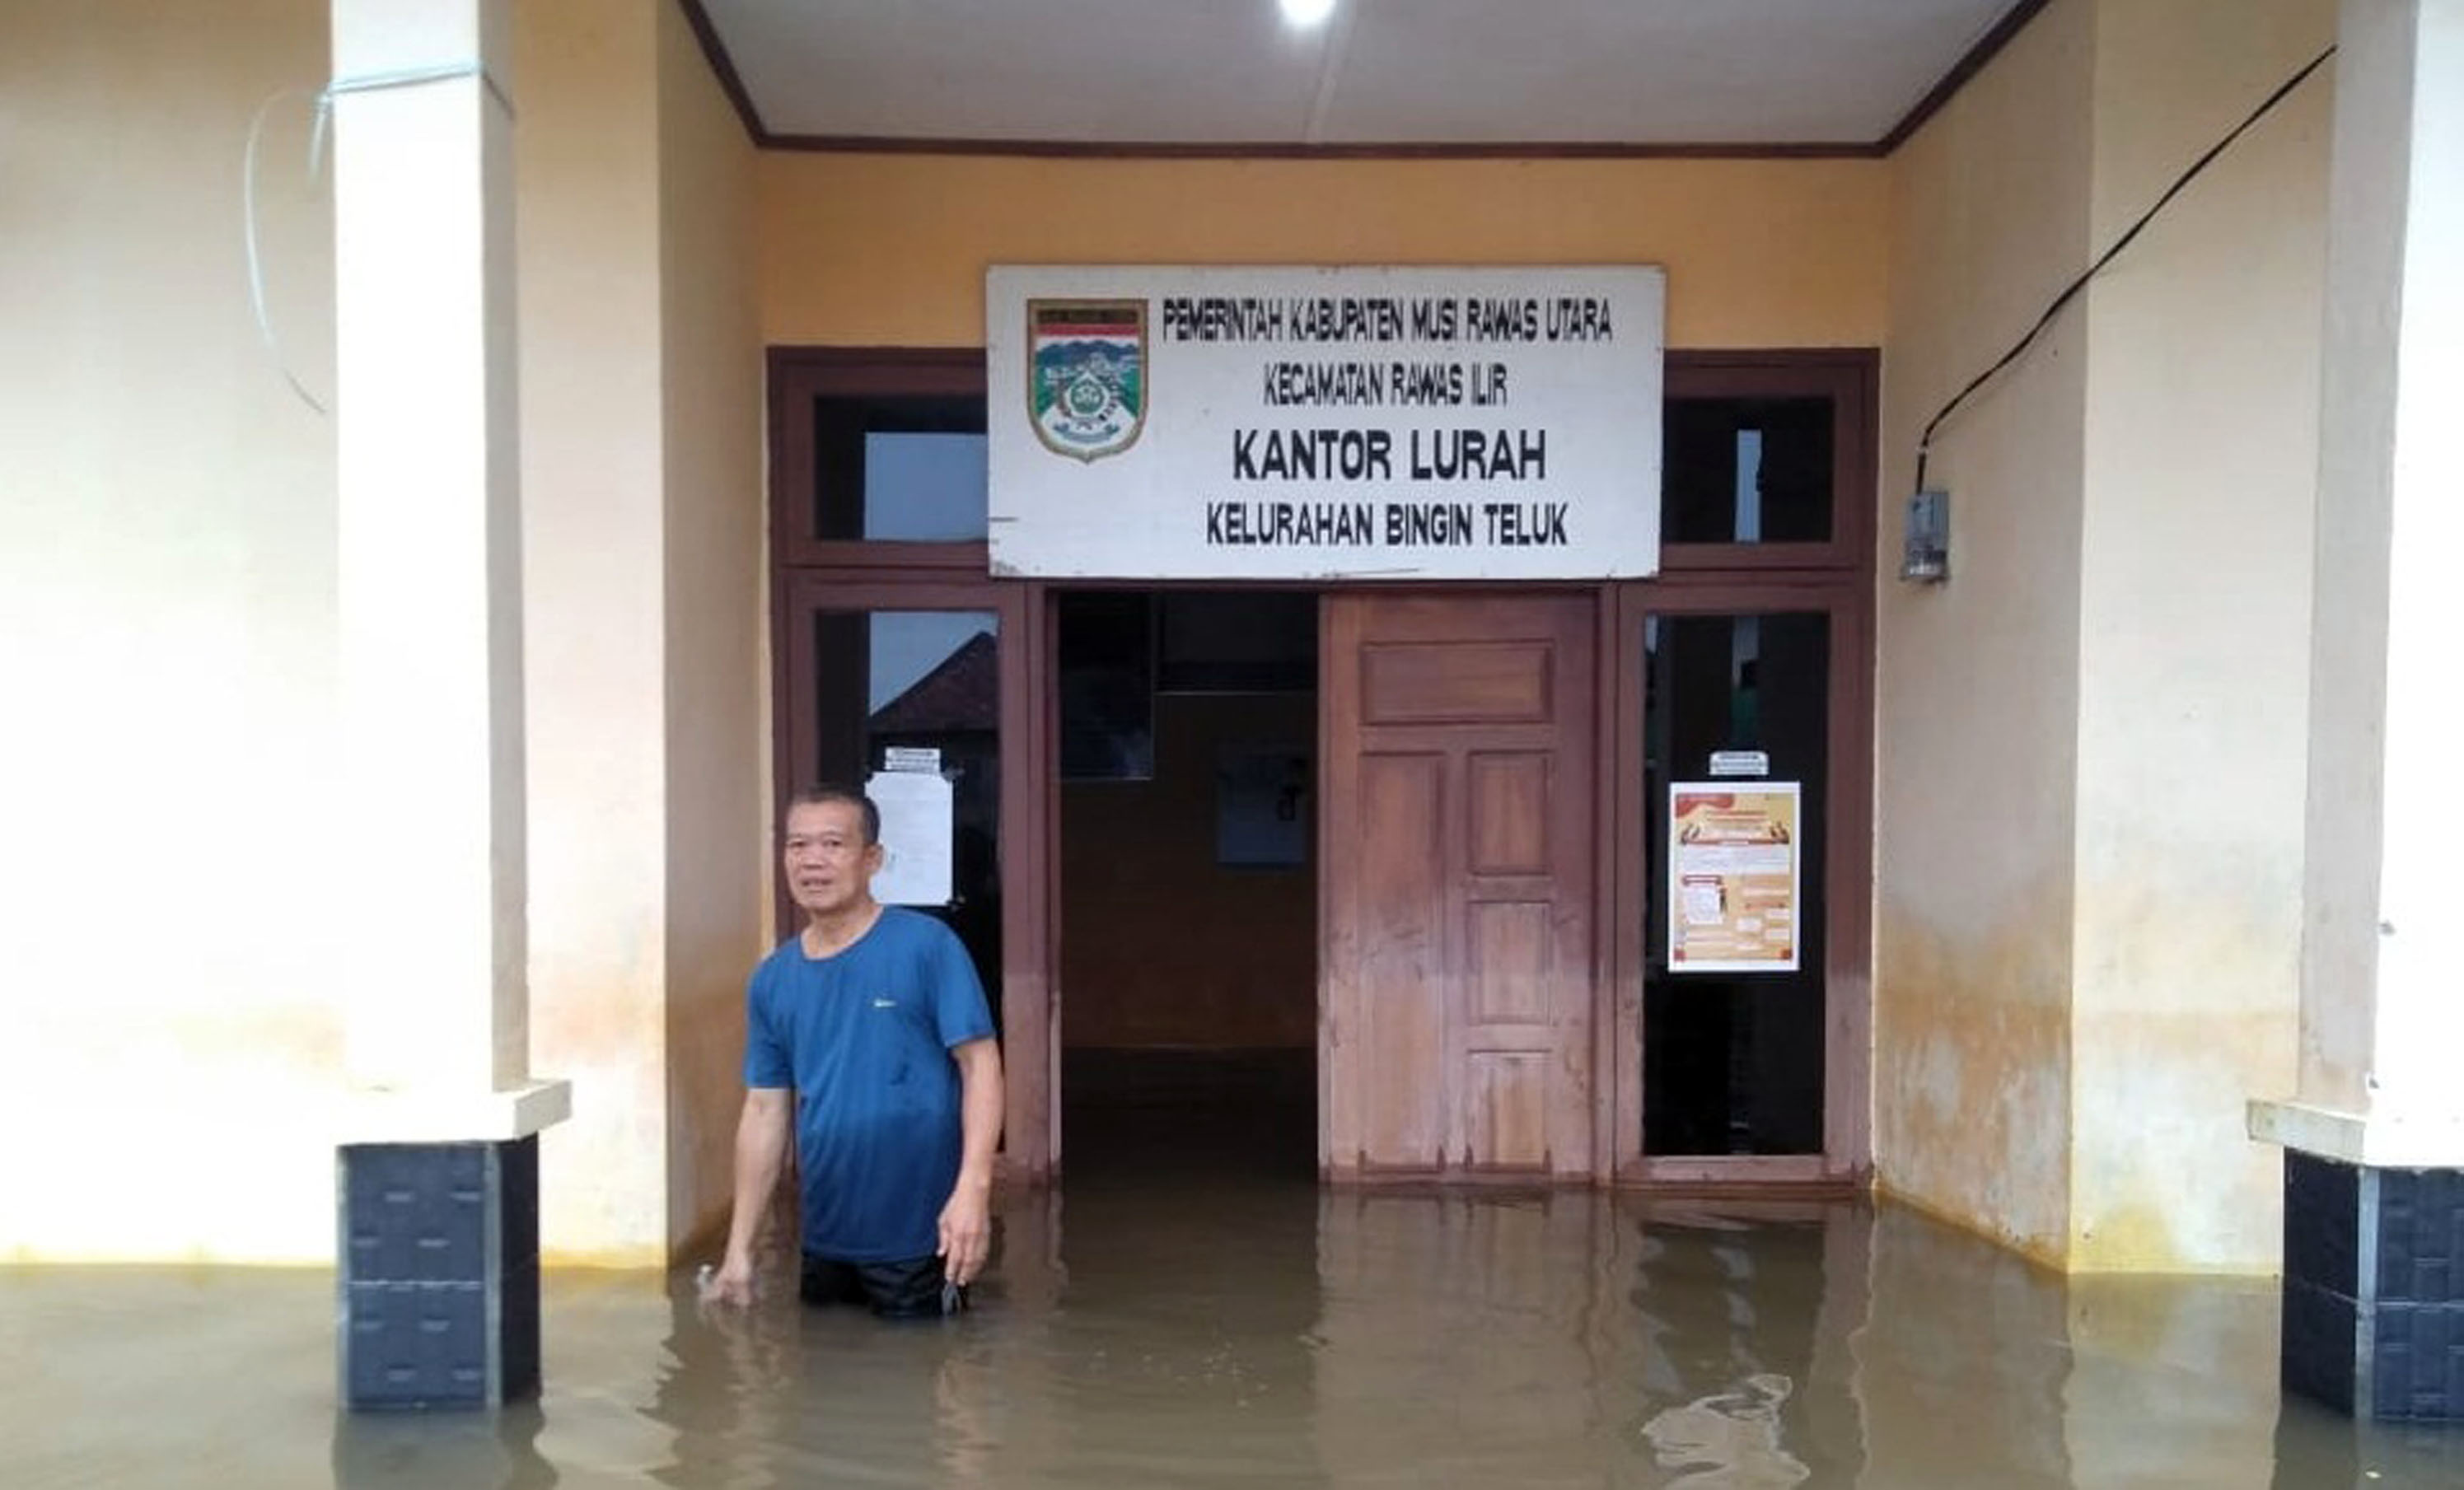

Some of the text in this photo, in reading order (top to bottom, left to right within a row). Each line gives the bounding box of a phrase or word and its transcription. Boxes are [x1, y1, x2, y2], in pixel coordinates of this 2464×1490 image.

[1162, 297, 1613, 342] PEMERINTAH KABUPATEN MUSI RAWAS UTARA
[1264, 362, 1508, 406] KECAMATAN RAWAS ILIR
[1233, 429, 1545, 480] KANTOR LURAH
[1207, 502, 1568, 546] KELURAHAN BINGIN TELUK
